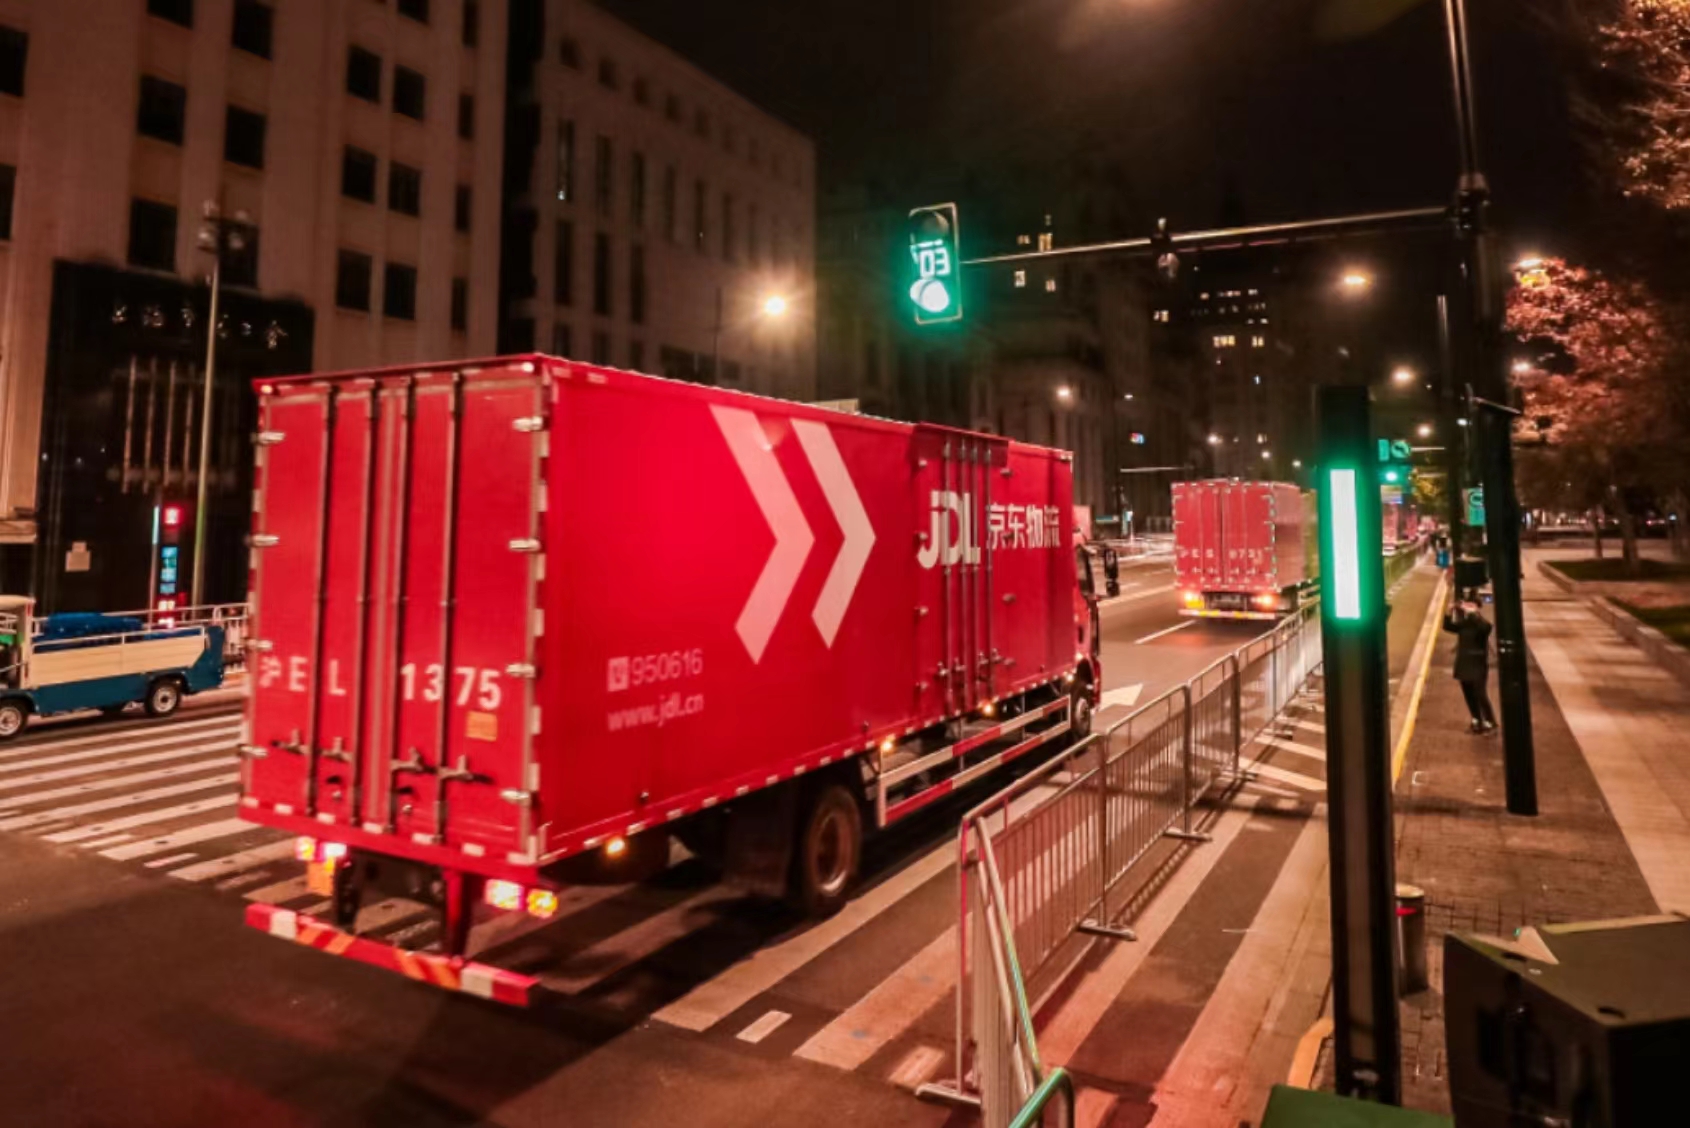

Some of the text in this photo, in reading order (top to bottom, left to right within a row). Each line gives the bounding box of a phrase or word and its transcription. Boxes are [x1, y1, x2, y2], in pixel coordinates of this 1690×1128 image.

[917, 490, 1061, 569] JDL 京东物流
[400, 662, 502, 711] 1375
[607, 692, 705, 732] www.jdl.cn
